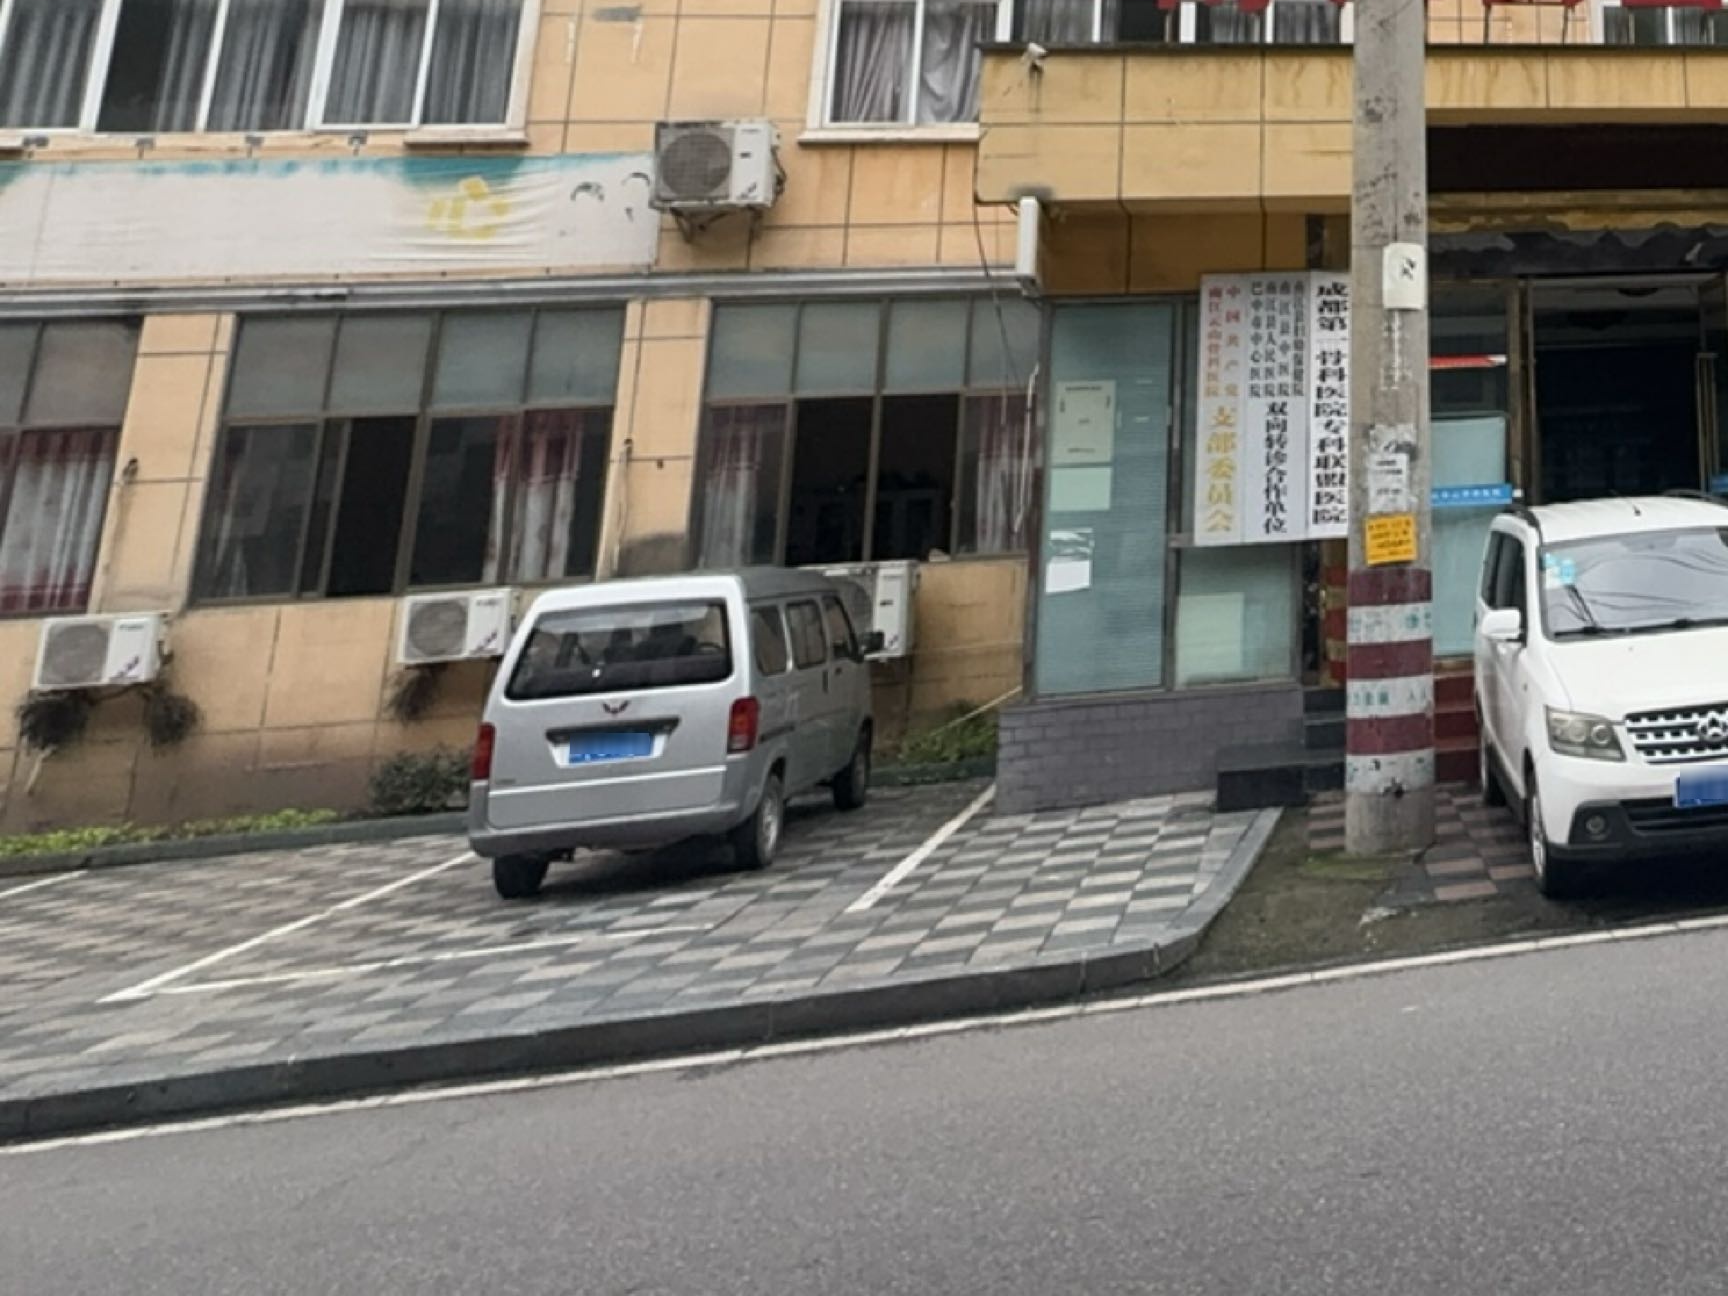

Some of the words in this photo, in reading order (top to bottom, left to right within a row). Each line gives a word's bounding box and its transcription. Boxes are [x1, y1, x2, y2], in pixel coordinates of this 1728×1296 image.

[1205, 406, 1237, 533] 支部委员会
